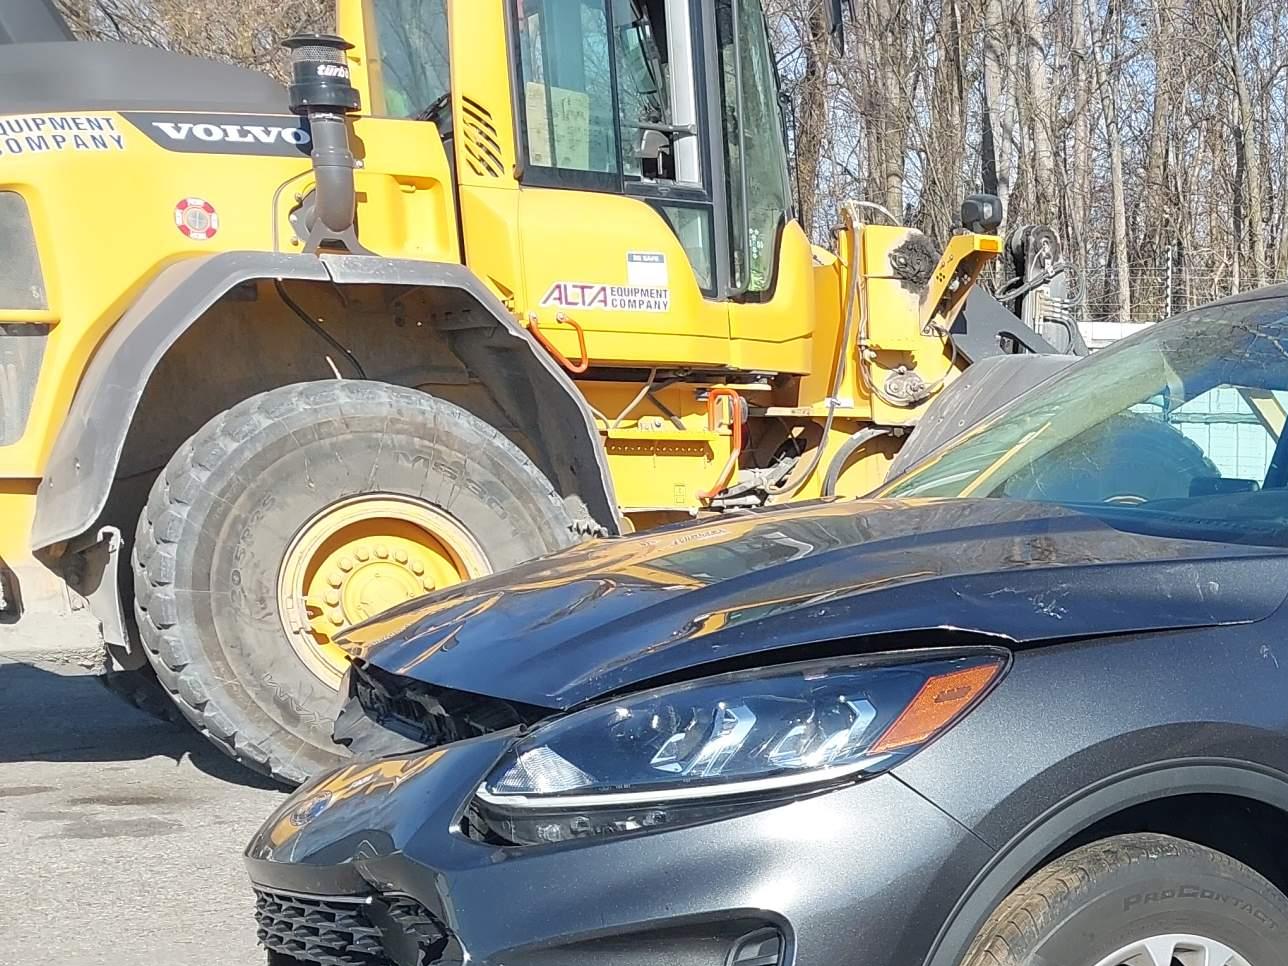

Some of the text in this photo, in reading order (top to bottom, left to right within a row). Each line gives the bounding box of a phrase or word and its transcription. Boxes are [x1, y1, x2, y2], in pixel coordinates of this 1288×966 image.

[0, 134, 124, 155] OMPANY
[152, 122, 311, 145] VOLVO
[541, 283, 669, 307] ALTA EQUIPMENT
[611, 298, 669, 311] COMPANY
